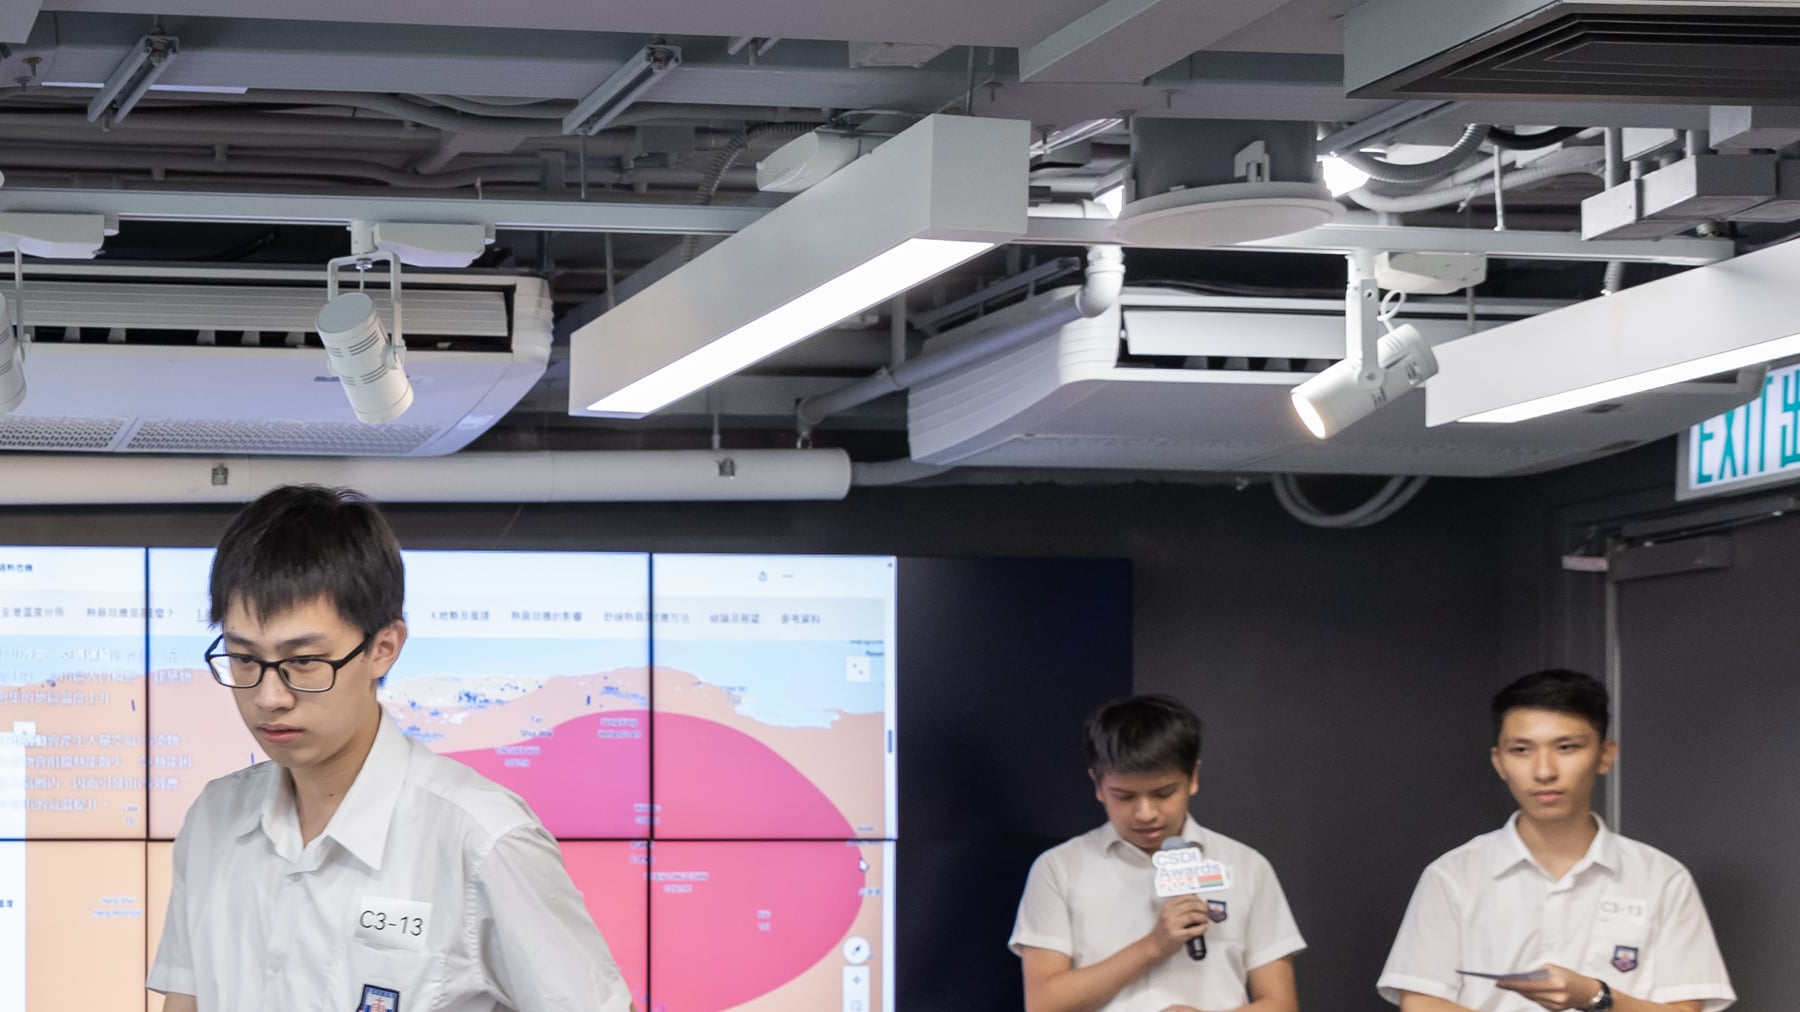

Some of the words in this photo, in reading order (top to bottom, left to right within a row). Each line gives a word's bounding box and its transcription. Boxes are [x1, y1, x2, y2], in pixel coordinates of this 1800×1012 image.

[1697, 376, 1773, 484] EXIT
[1156, 852, 1197, 866] CSDI
[1160, 863, 1221, 878] Awards
[360, 910, 423, 936] C3-13
